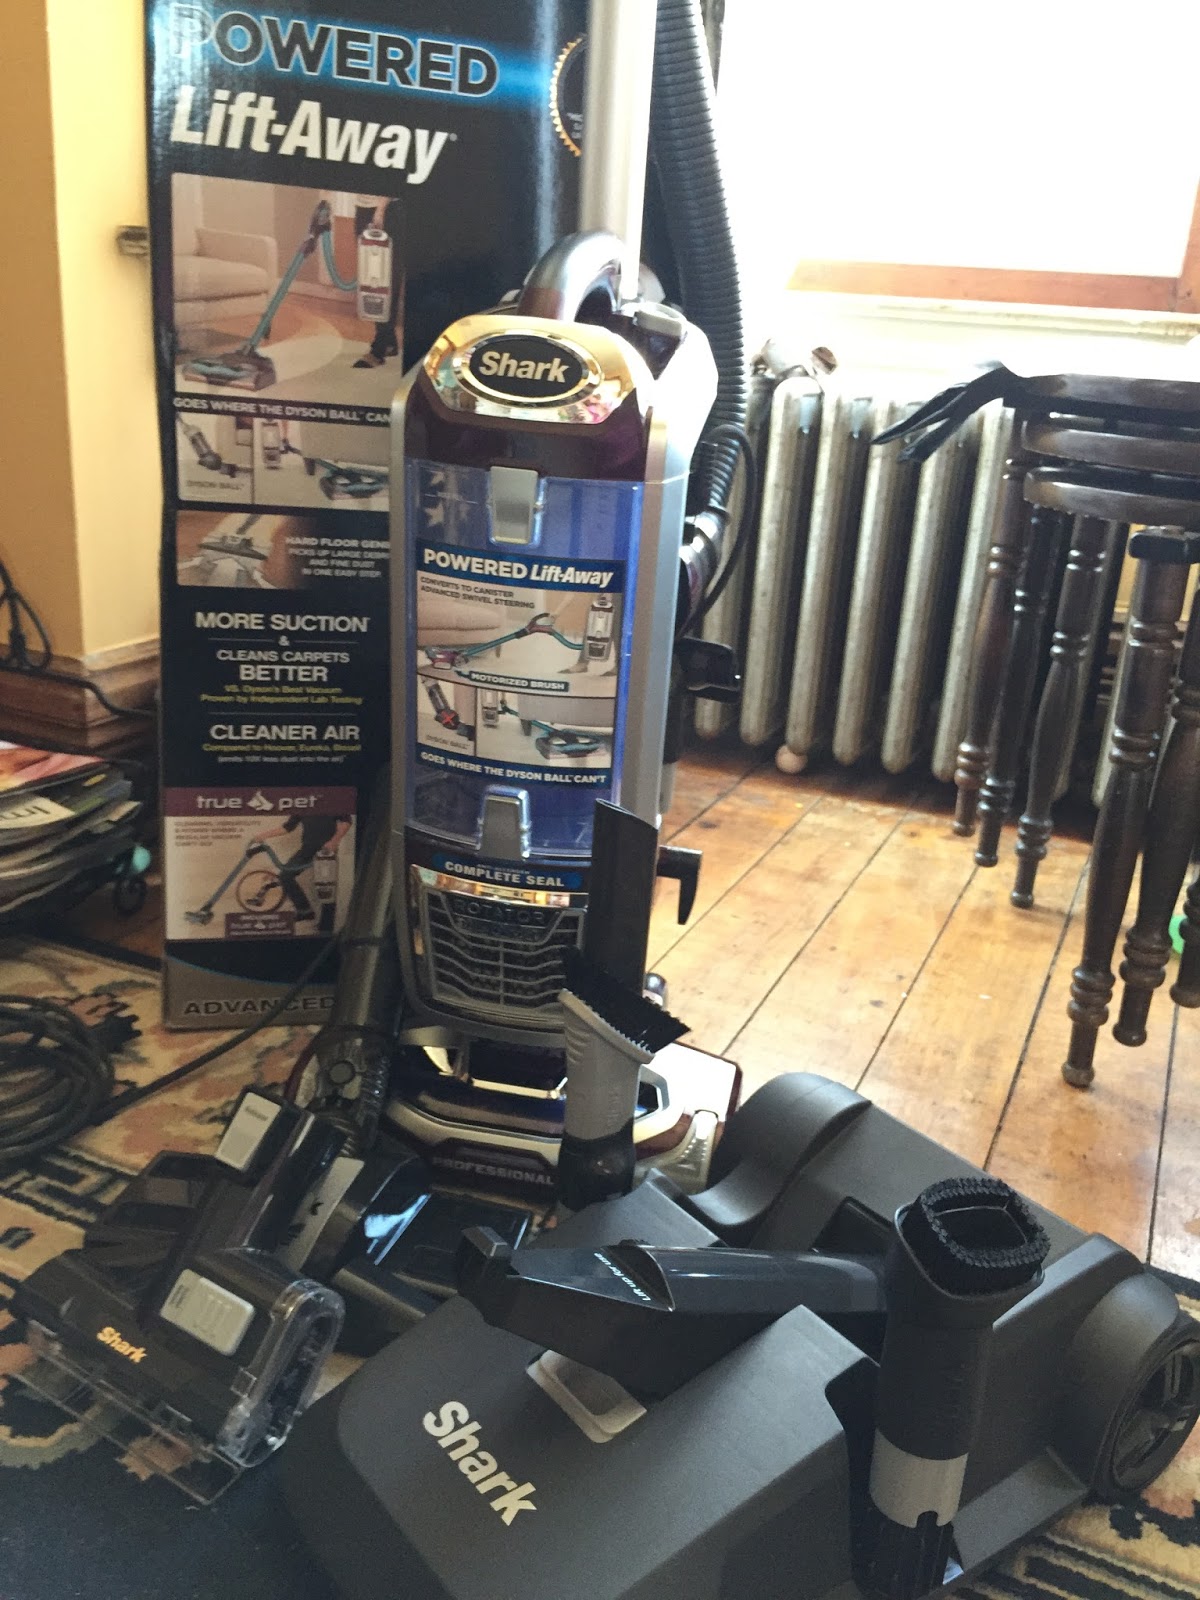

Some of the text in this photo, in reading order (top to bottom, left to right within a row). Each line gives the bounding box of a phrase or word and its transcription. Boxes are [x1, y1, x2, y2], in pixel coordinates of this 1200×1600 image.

[170, 3, 498, 98] POWERED
[171, 85, 448, 185] Lift-Away
[479, 351, 570, 383] Shark
[173, 398, 209, 410] GOES
[210, 401, 257, 413] WHERE
[260, 404, 283, 415] THE
[285, 406, 327, 419] DYSON
[366, 412, 391, 423] CAN
[424, 548, 614, 589] POWERED Lift-Away
[420, 576, 514, 598] CONVERTS TO CANISTER
[494, 598, 535, 609] STEERING
[195, 612, 369, 633] MORE SUCTION
[278, 635, 290, 647] &
[216, 650, 351, 664] CLEANS CARPETS
[239, 664, 329, 682] BETTER
[470, 672, 565, 690] MOTORIZED BRUSH
[209, 724, 361, 741] CLEANER AIR
[420, 751, 445, 765] GOES
[447, 758, 482, 773] WHERE
[484, 765, 505, 777] THE
[506, 769, 542, 781] DYSON
[573, 774, 607, 784] CAN'T
[196, 794, 318, 811] true pet
[444, 861, 521, 883] COMPLETE
[526, 875, 565, 887] SEAL
[96, 1326, 148, 1364] Shark
[422, 1401, 537, 1526] Shark
